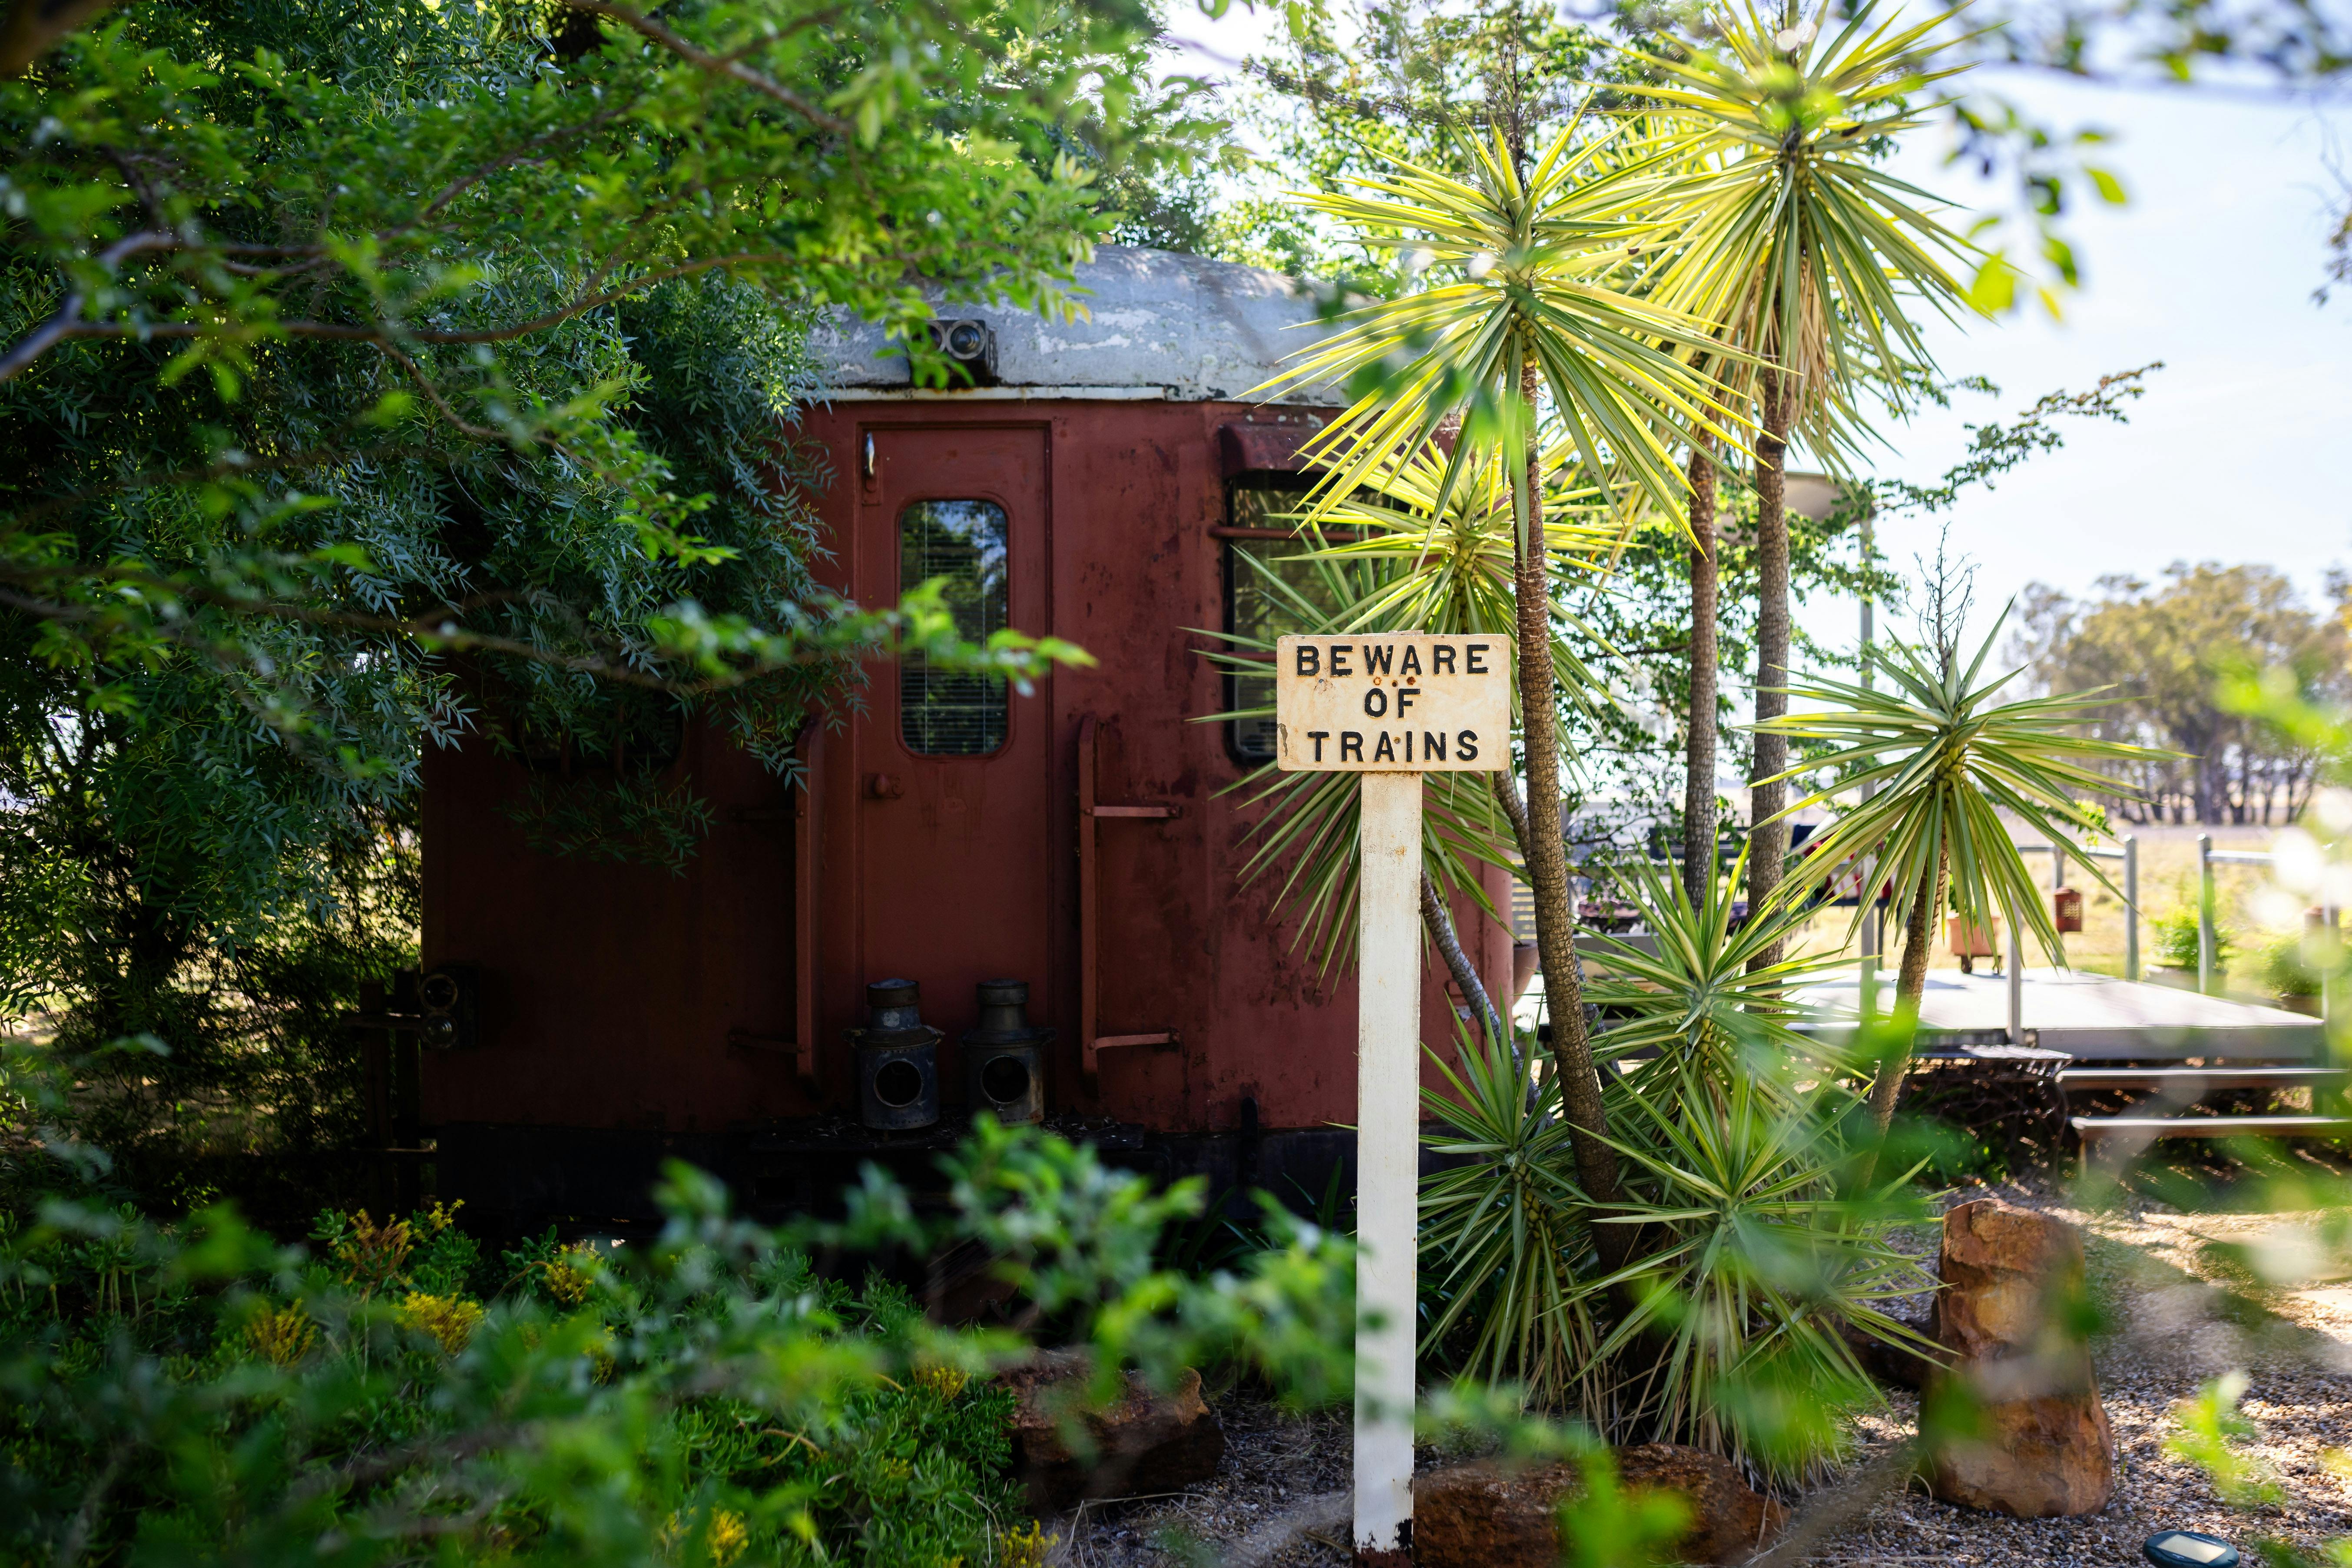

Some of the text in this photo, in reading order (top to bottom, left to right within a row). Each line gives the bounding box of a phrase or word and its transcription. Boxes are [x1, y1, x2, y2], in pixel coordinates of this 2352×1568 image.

[1296, 644, 1490, 677] BEWARE
[1364, 688, 1421, 719] OF
[1307, 729, 1479, 762] TRAINS
